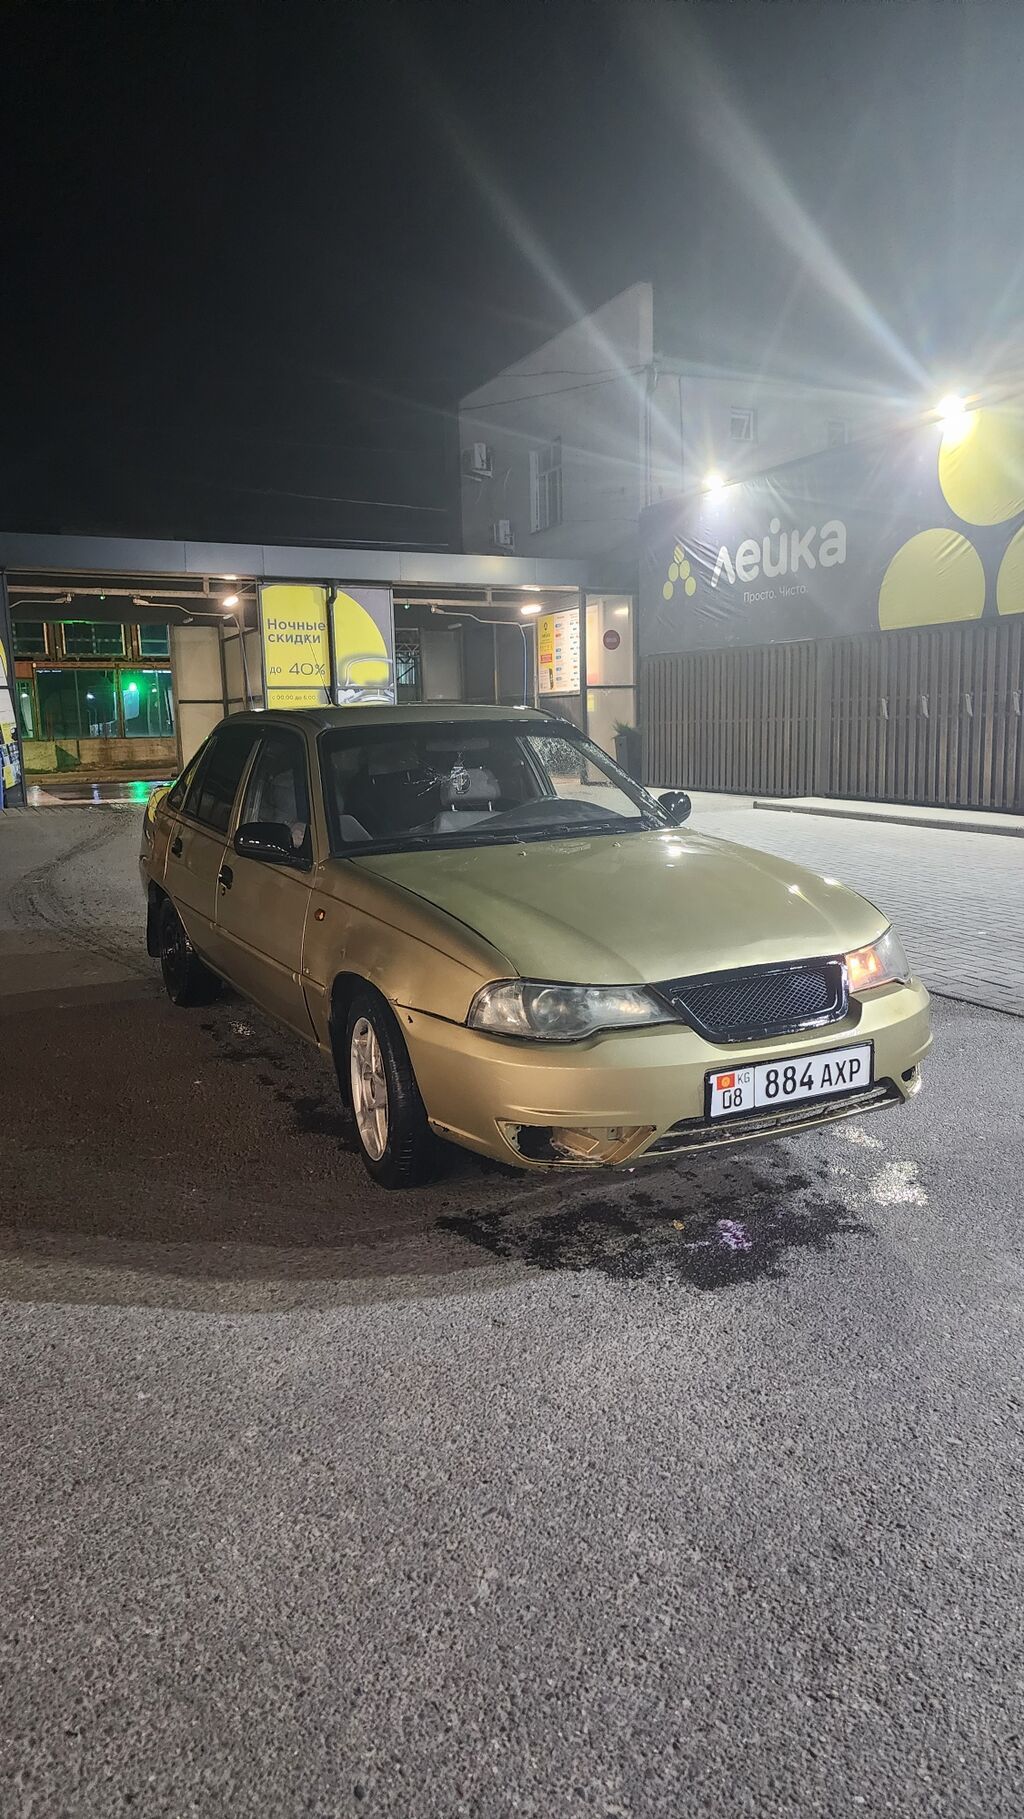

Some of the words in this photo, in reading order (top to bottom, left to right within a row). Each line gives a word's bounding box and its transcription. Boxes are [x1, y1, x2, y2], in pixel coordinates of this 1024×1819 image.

[743, 589, 777, 605] Просто.
[779, 585, 809, 597] Чисто.
[267, 618, 326, 631] Ночные
[268, 633, 321, 645] скидки
[269, 666, 282, 675] до
[288, 662, 326, 676] 40%
[737, 1071, 751, 1085] KG
[765, 1062, 814, 1099] 884
[820, 1058, 861, 1089] AXP
[722, 1088, 743, 1109] 08
